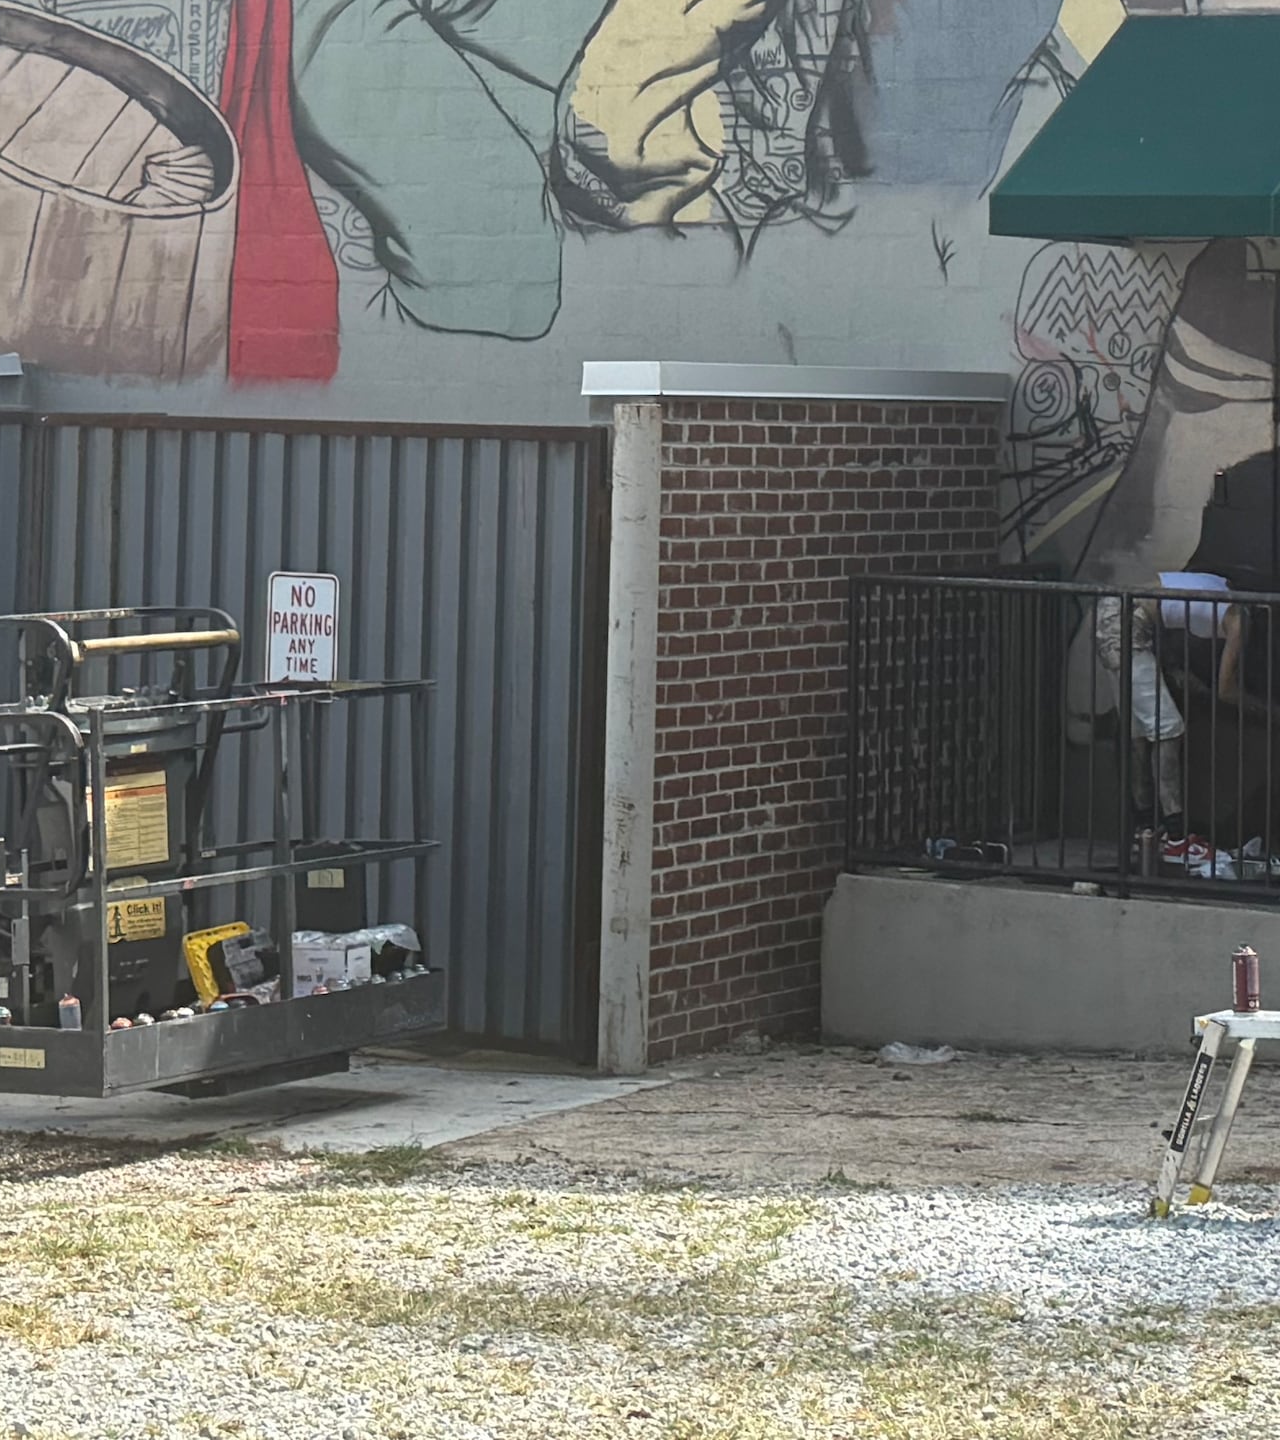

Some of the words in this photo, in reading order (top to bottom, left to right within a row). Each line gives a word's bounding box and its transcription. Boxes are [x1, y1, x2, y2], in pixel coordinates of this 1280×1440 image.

[290, 585, 316, 608] NO
[273, 611, 333, 637] PARKING
[288, 638, 316, 655] ANY
[285, 656, 319, 674] TIME
